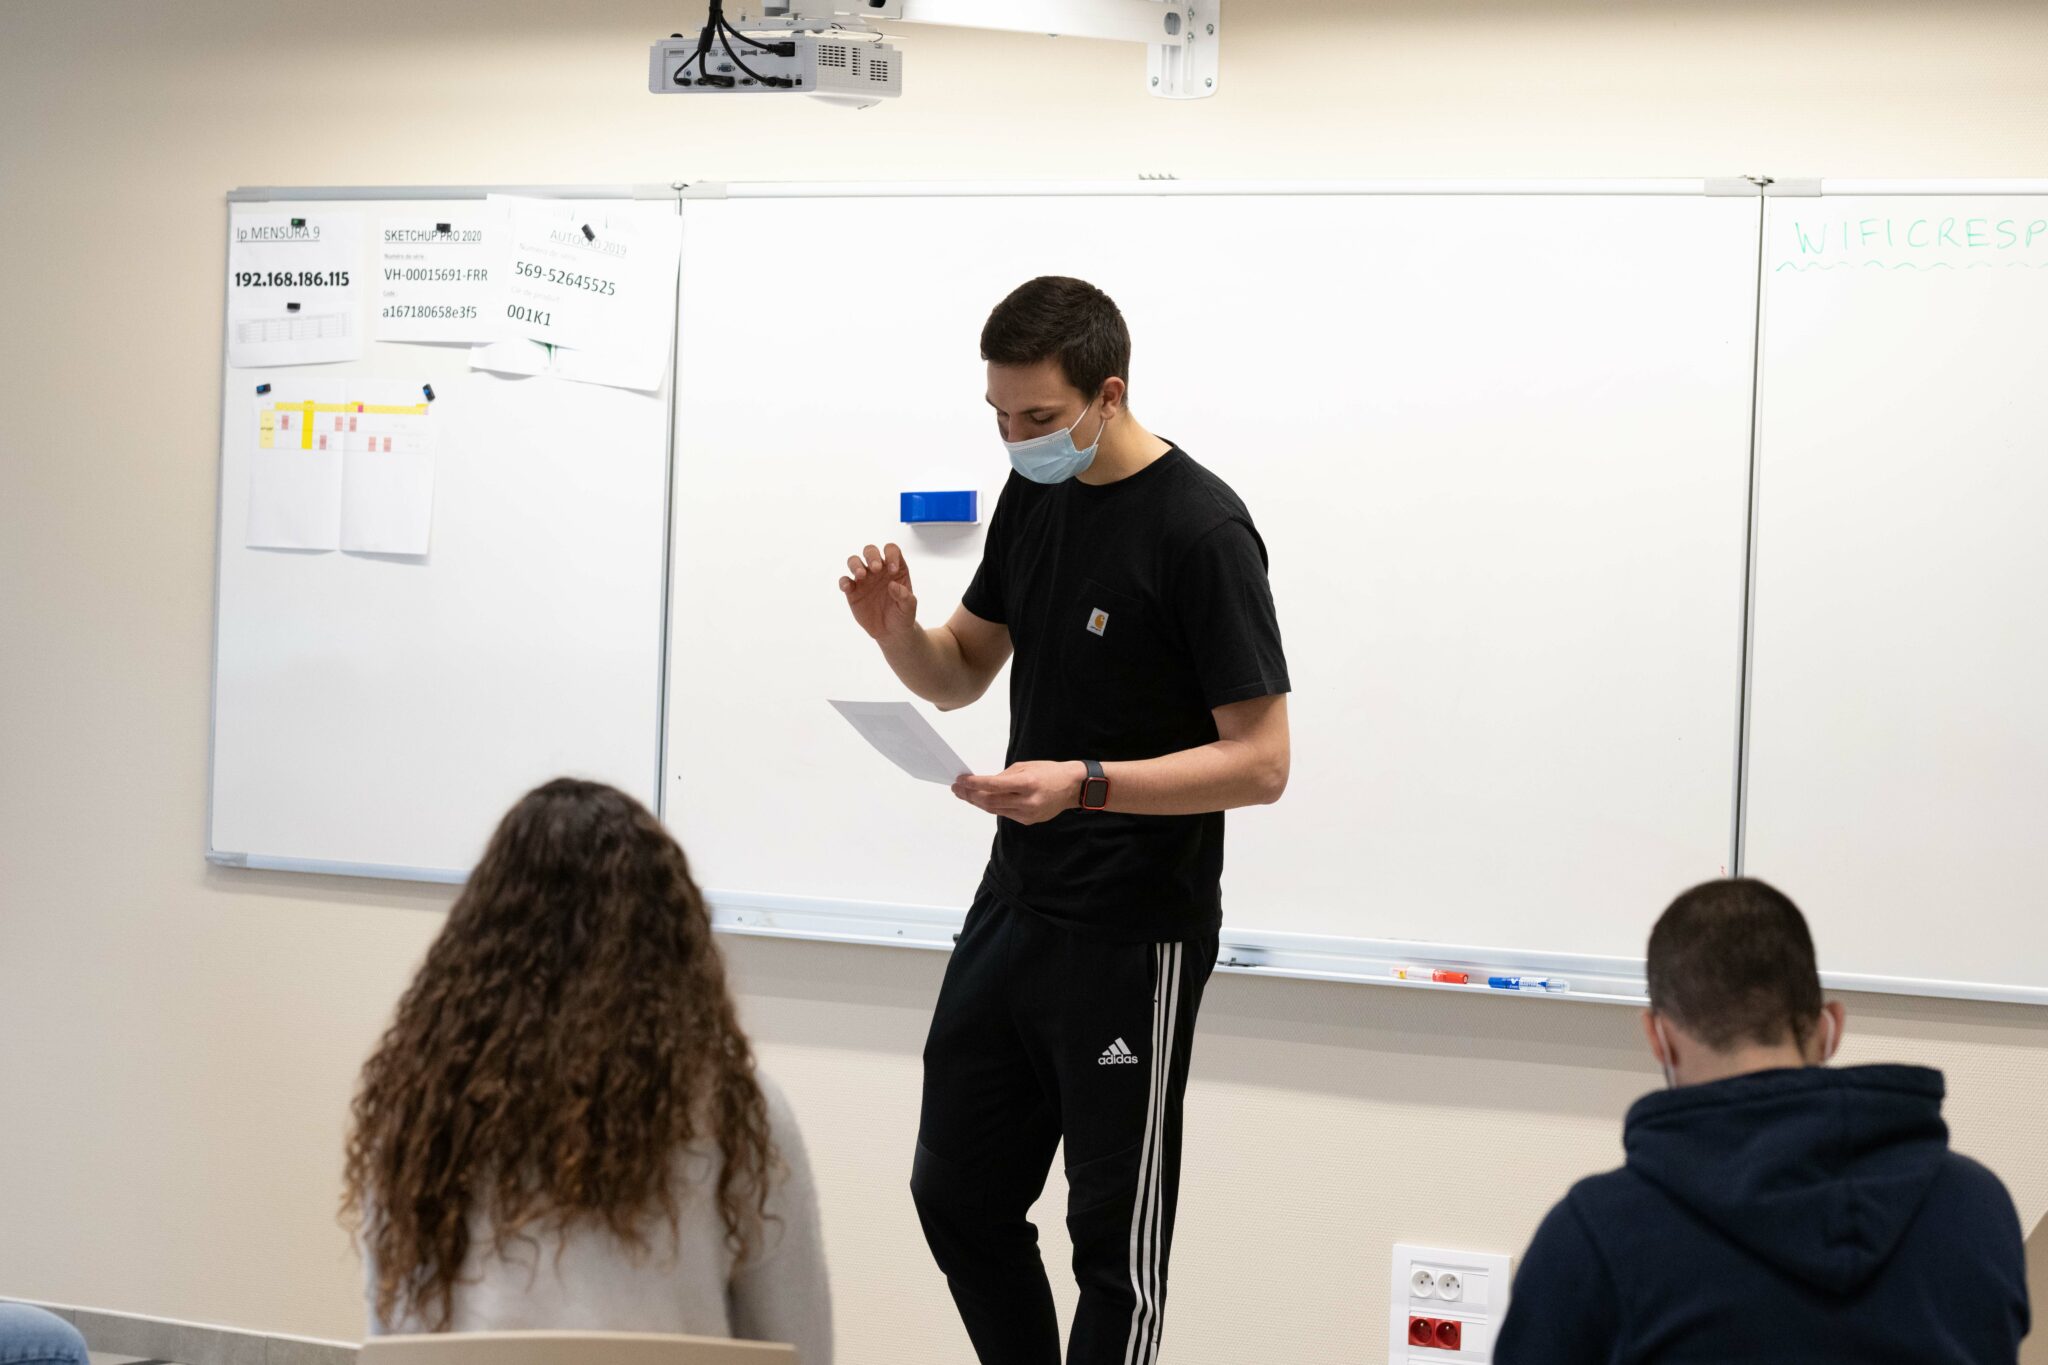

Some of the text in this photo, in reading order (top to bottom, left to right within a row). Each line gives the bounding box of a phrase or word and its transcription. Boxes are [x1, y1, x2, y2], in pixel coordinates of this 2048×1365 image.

[236, 225, 321, 242] Ip MENSURA 9
[384, 229, 482, 242] SKETCHUP PRO 2020
[234, 271, 350, 288] 192.168.186.115
[384, 268, 488, 281] VH-00015691-FRR
[514, 260, 616, 297] 569-52645525
[382, 305, 478, 319] a167180658e3f5
[506, 303, 552, 327] 001K1
[1097, 1053, 1139, 1066] adidas
